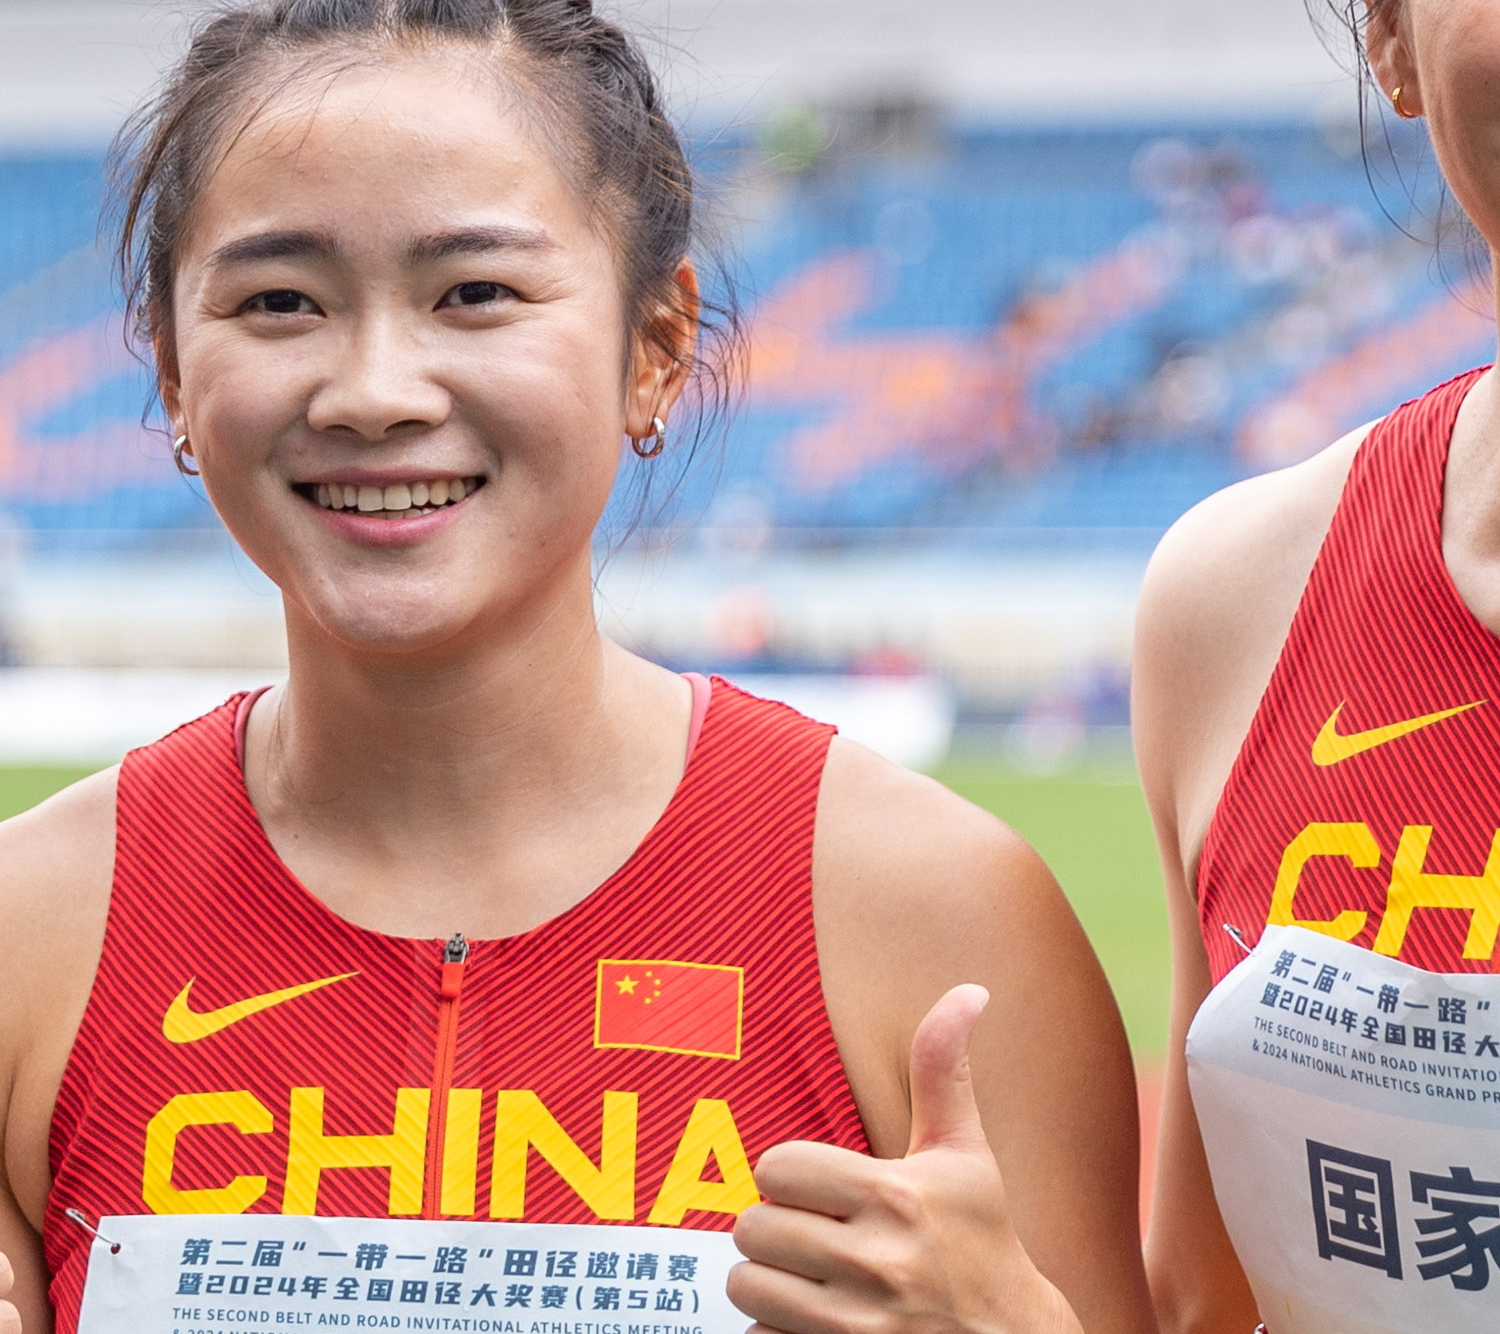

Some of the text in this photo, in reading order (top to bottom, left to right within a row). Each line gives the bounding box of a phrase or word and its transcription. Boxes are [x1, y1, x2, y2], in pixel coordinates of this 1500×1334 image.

[1252, 1038, 1260, 1052] &
[1262, 1041, 1288, 1060] 2024
[1291, 1051, 1347, 1079] NATIONAL
[1350, 1068, 1421, 1094] ATHLETICS
[1425, 1083, 1477, 1102] GRAND
[1254, 1016, 1273, 1033] THE
[1276, 1024, 1319, 1048] SECOND
[1322, 1039, 1347, 1057] BELT
[1351, 1049, 1376, 1065] AND
[1380, 1055, 1417, 1072] ROAD
[141, 1087, 761, 1225] CHINA
[172, 1307, 201, 1320] THE
[206, 1308, 270, 1323] SECOND
[276, 1310, 313, 1325] BELT
[317, 1312, 351, 1326] AND
[357, 1314, 401, 1328] ROAD
[407, 1317, 524, 1333] INVITATIONAL
